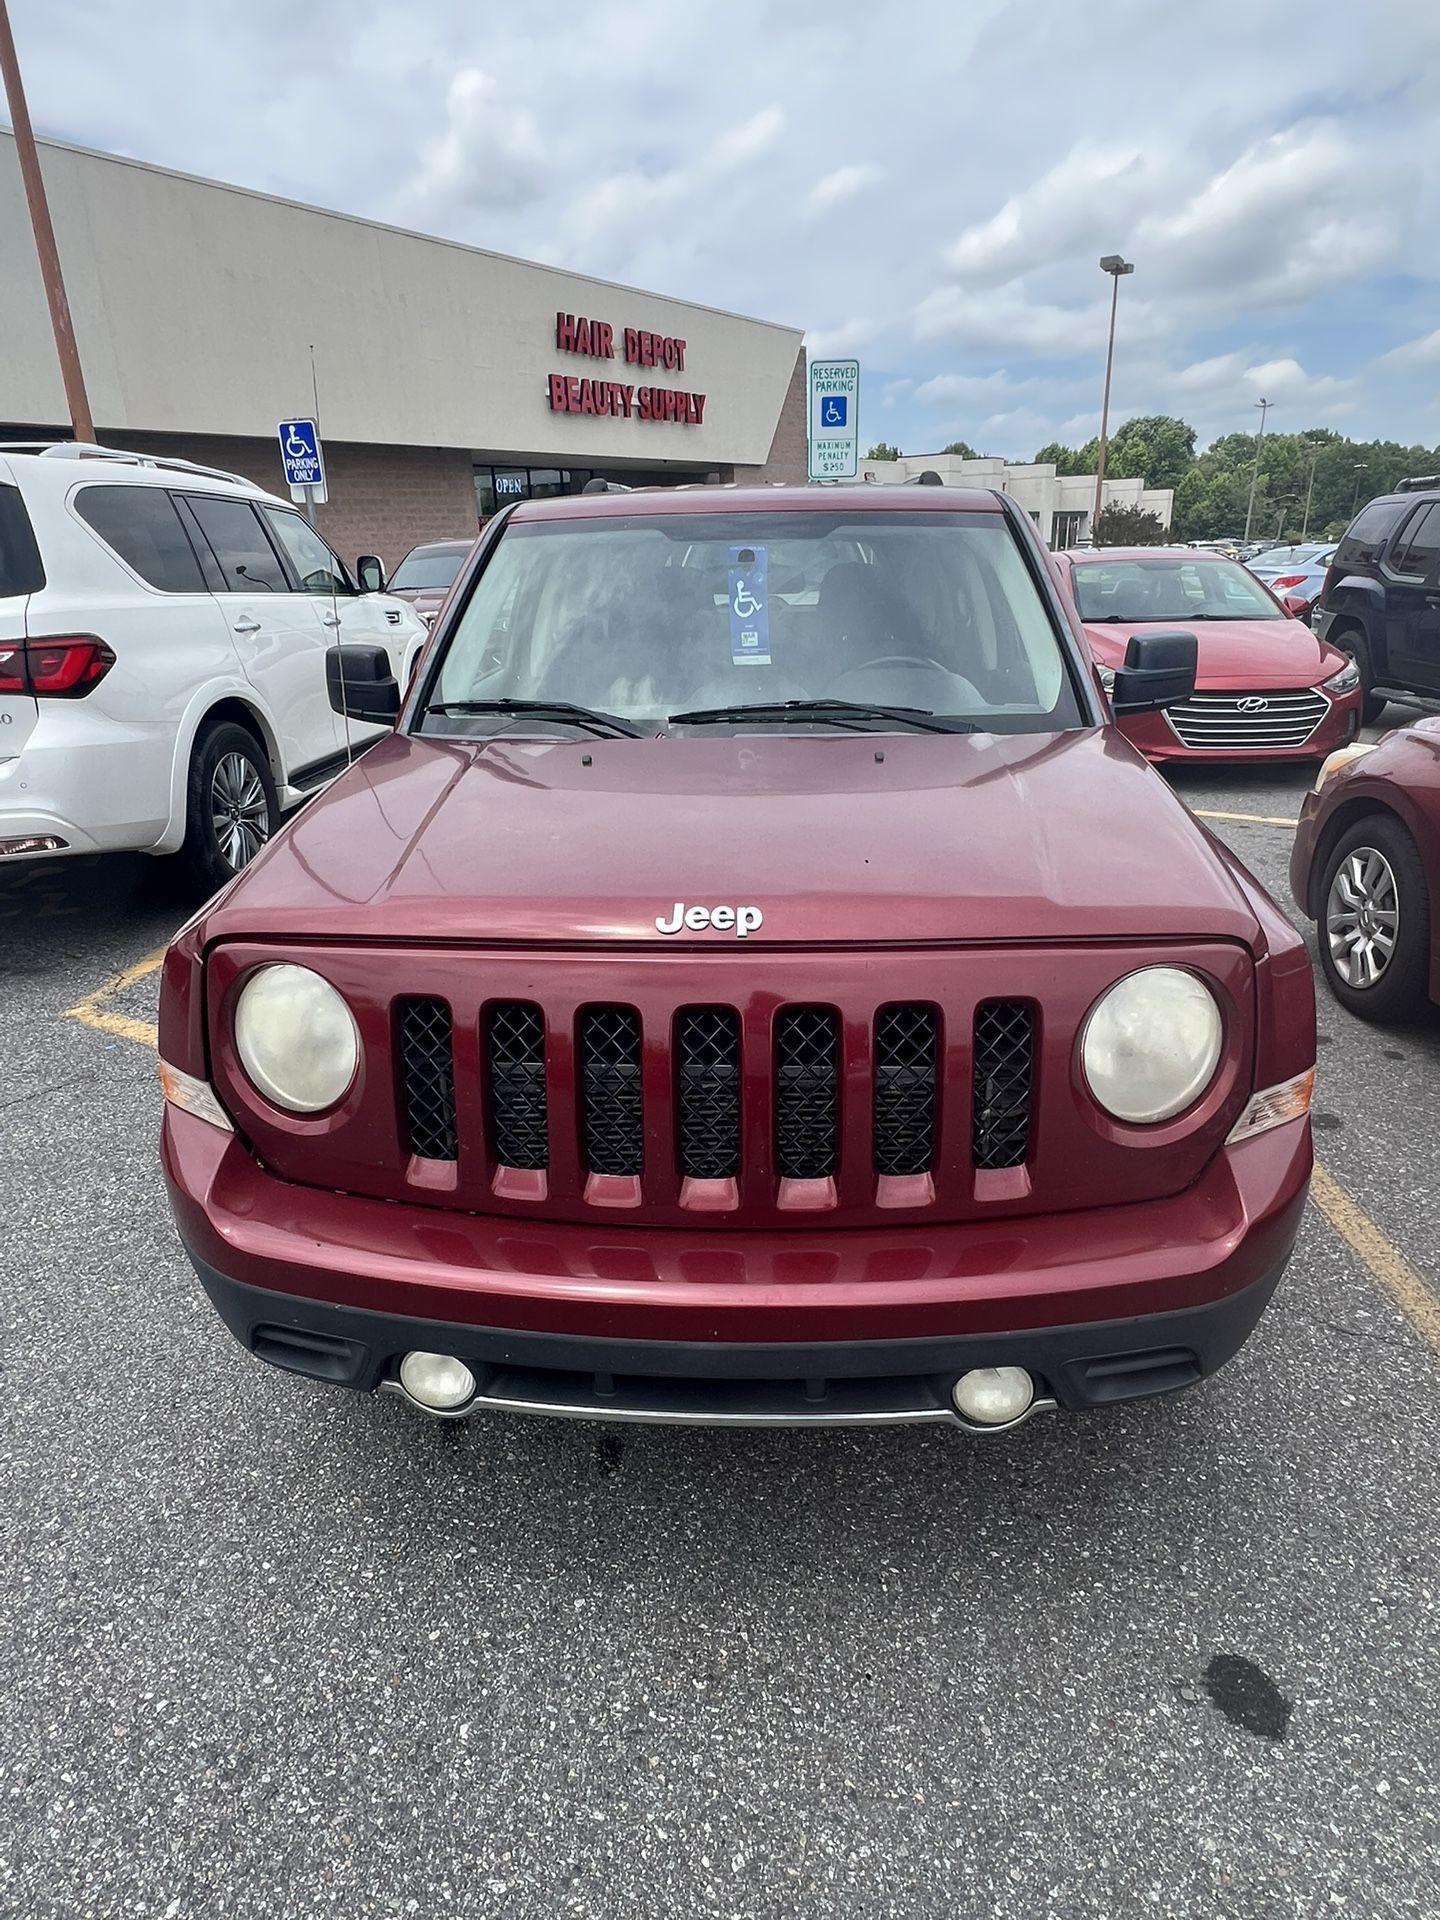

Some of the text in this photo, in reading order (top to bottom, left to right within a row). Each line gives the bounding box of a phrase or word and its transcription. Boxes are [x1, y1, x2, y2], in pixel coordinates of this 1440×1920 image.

[556, 312, 687, 371] HAIR DEPOT
[813, 367, 857, 380] RESERVED
[815, 380, 854, 393] PARKING
[548, 374, 706, 425] BEAUTY SUPPLY
[816, 441, 851, 450] MAXIMUM
[818, 452, 849, 462] PENALTY
[286, 457, 319, 471] PARKING
[293, 469, 314, 482] ONLY
[495, 478, 522, 494] OPEN
[655, 902, 763, 938] Jeep
